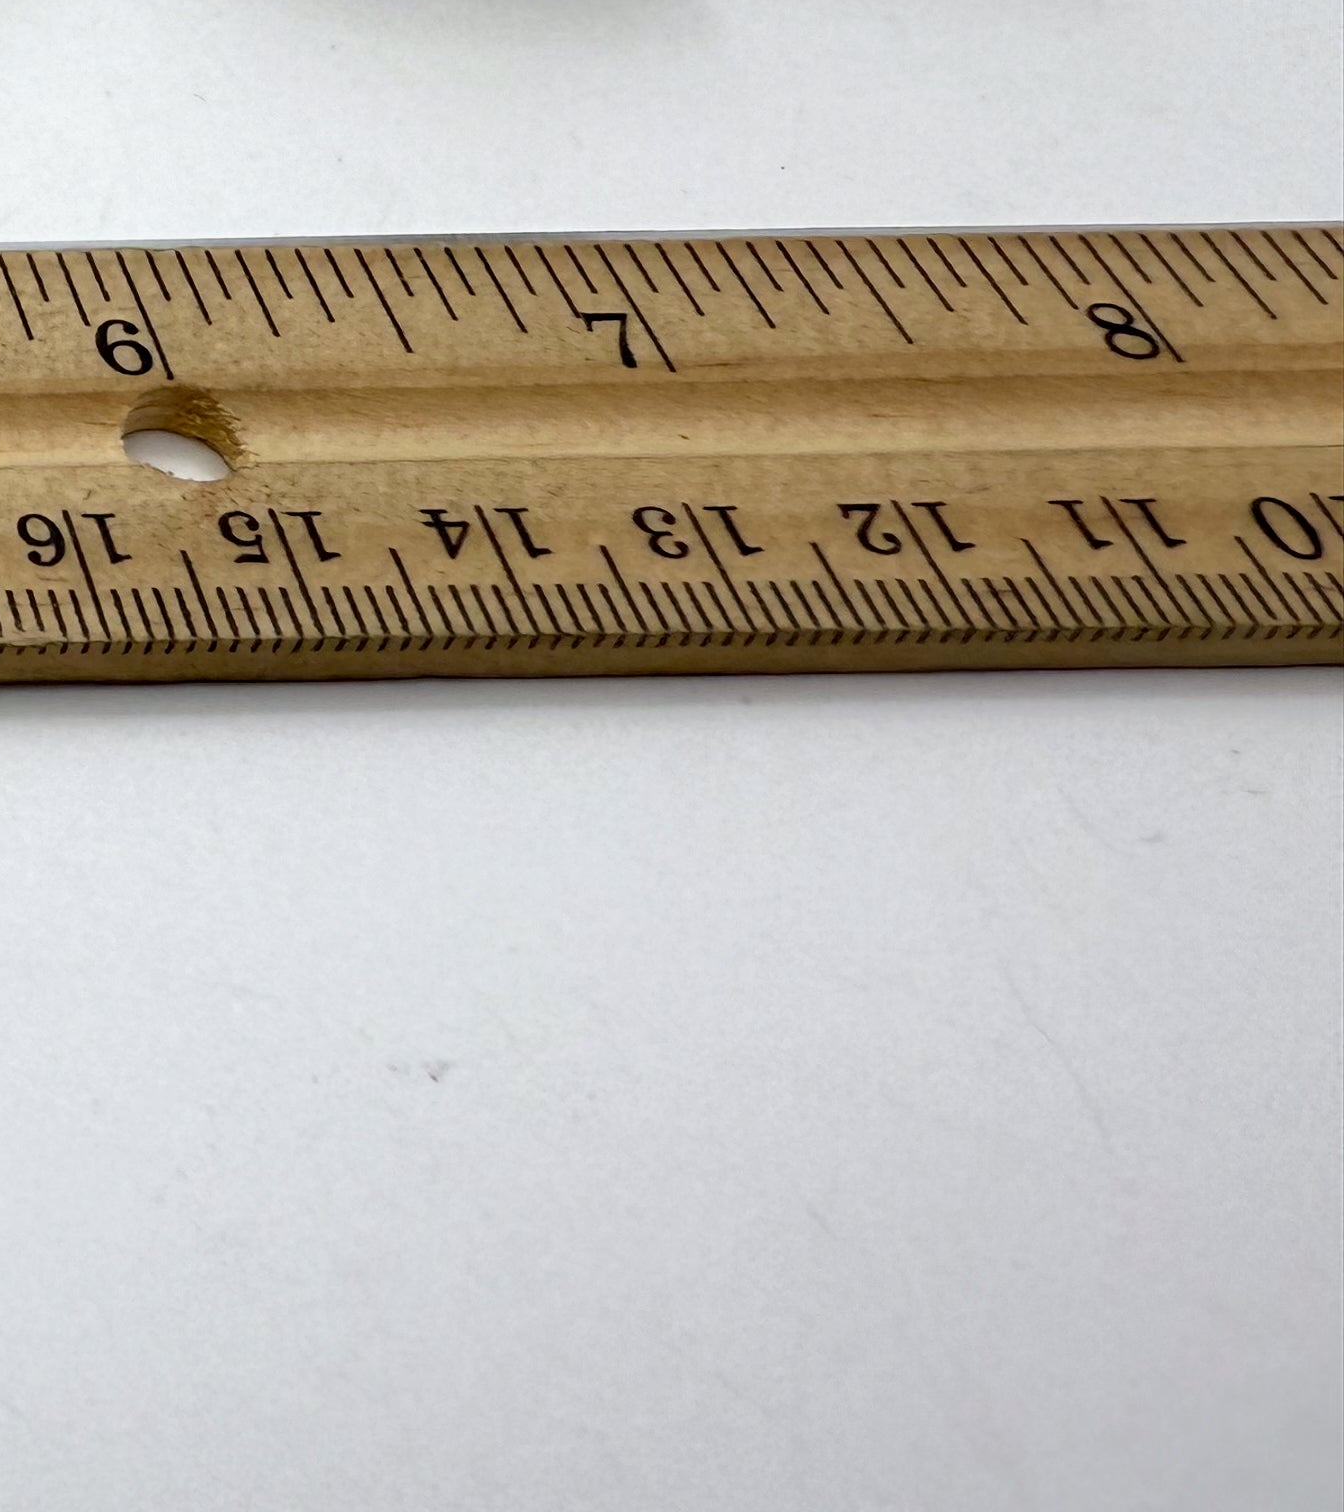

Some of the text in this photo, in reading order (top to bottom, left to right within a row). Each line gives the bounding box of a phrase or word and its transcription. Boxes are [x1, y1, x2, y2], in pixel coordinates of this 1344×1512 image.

[95, 320, 154, 377] 6
[583, 312, 638, 369] 7
[1087, 302, 1161, 360] 8
[17, 513, 133, 567] 16
[217, 510, 342, 564] 15
[418, 507, 554, 560] 14
[631, 504, 765, 559] 13
[838, 502, 976, 556] 12
[1048, 497, 1188, 551] 11
[1250, 495, 1344, 561] 0
